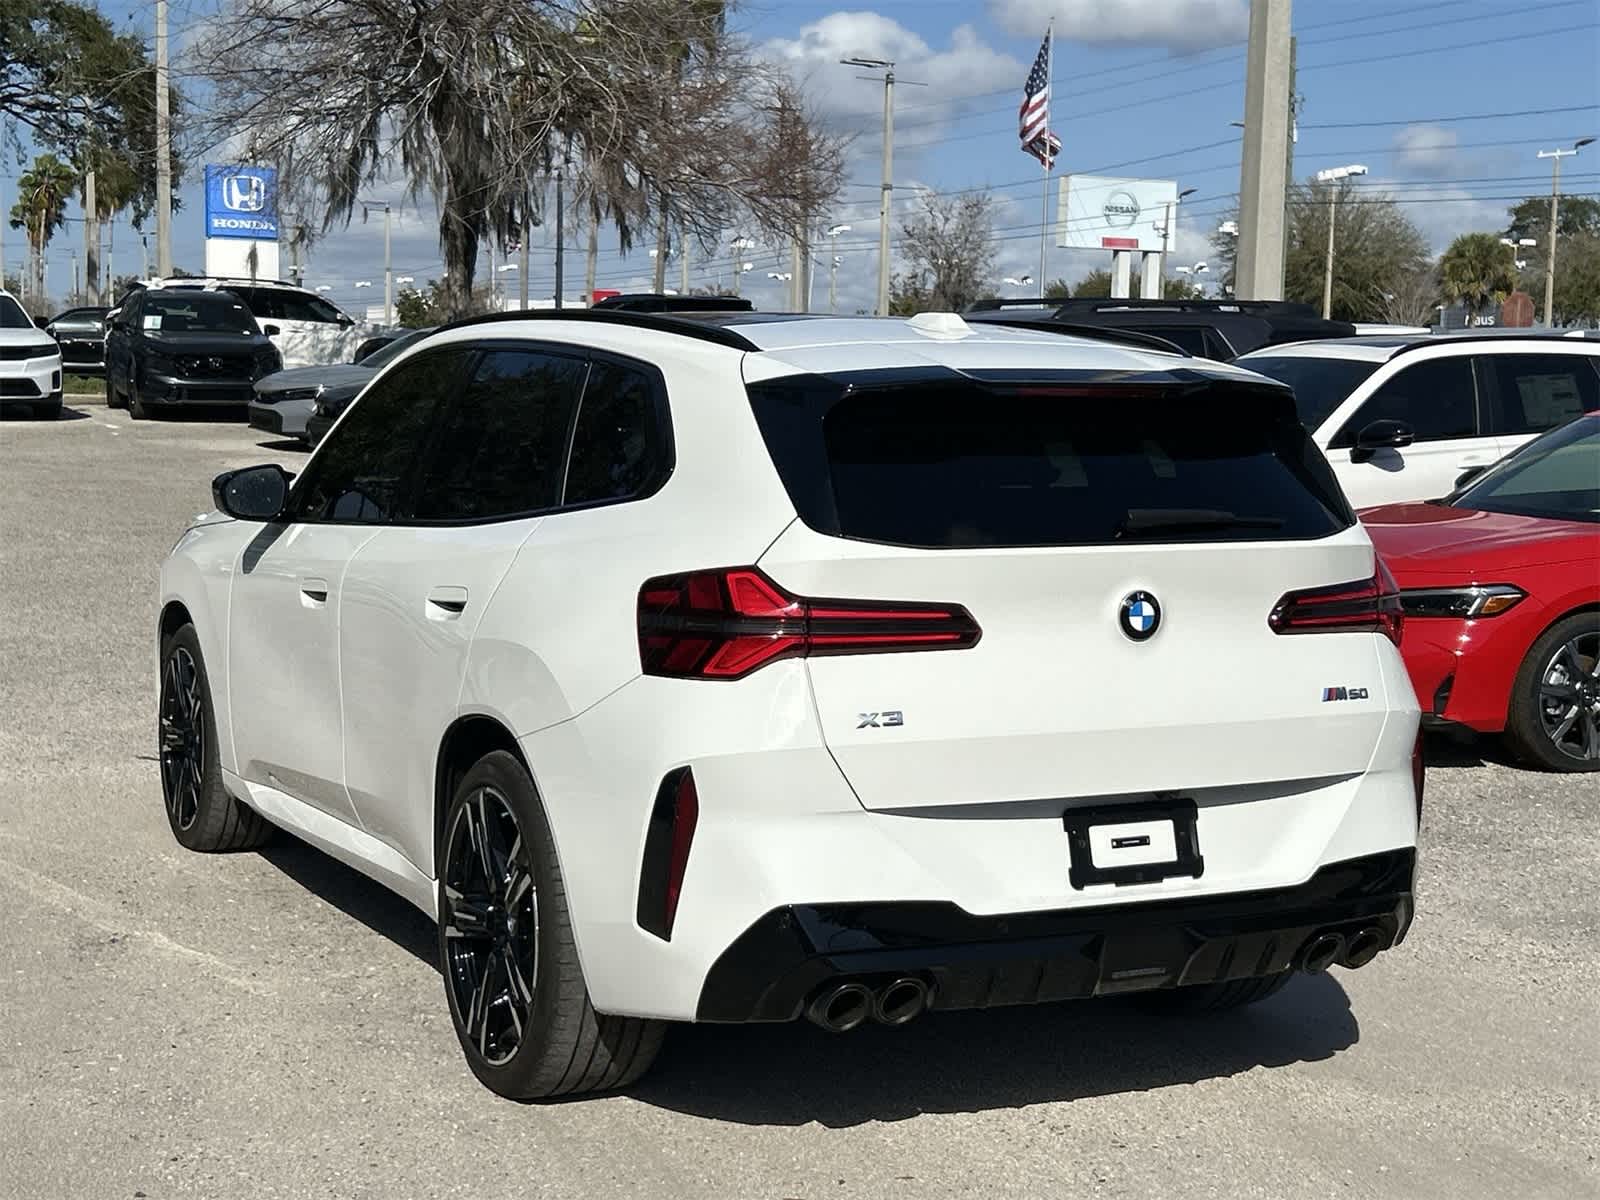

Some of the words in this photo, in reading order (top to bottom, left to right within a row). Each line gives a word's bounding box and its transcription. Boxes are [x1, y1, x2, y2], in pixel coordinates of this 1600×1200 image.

[1104, 205, 1137, 214] NISSAN
[212, 218, 276, 232] HONDA
[856, 711, 904, 729] X3
